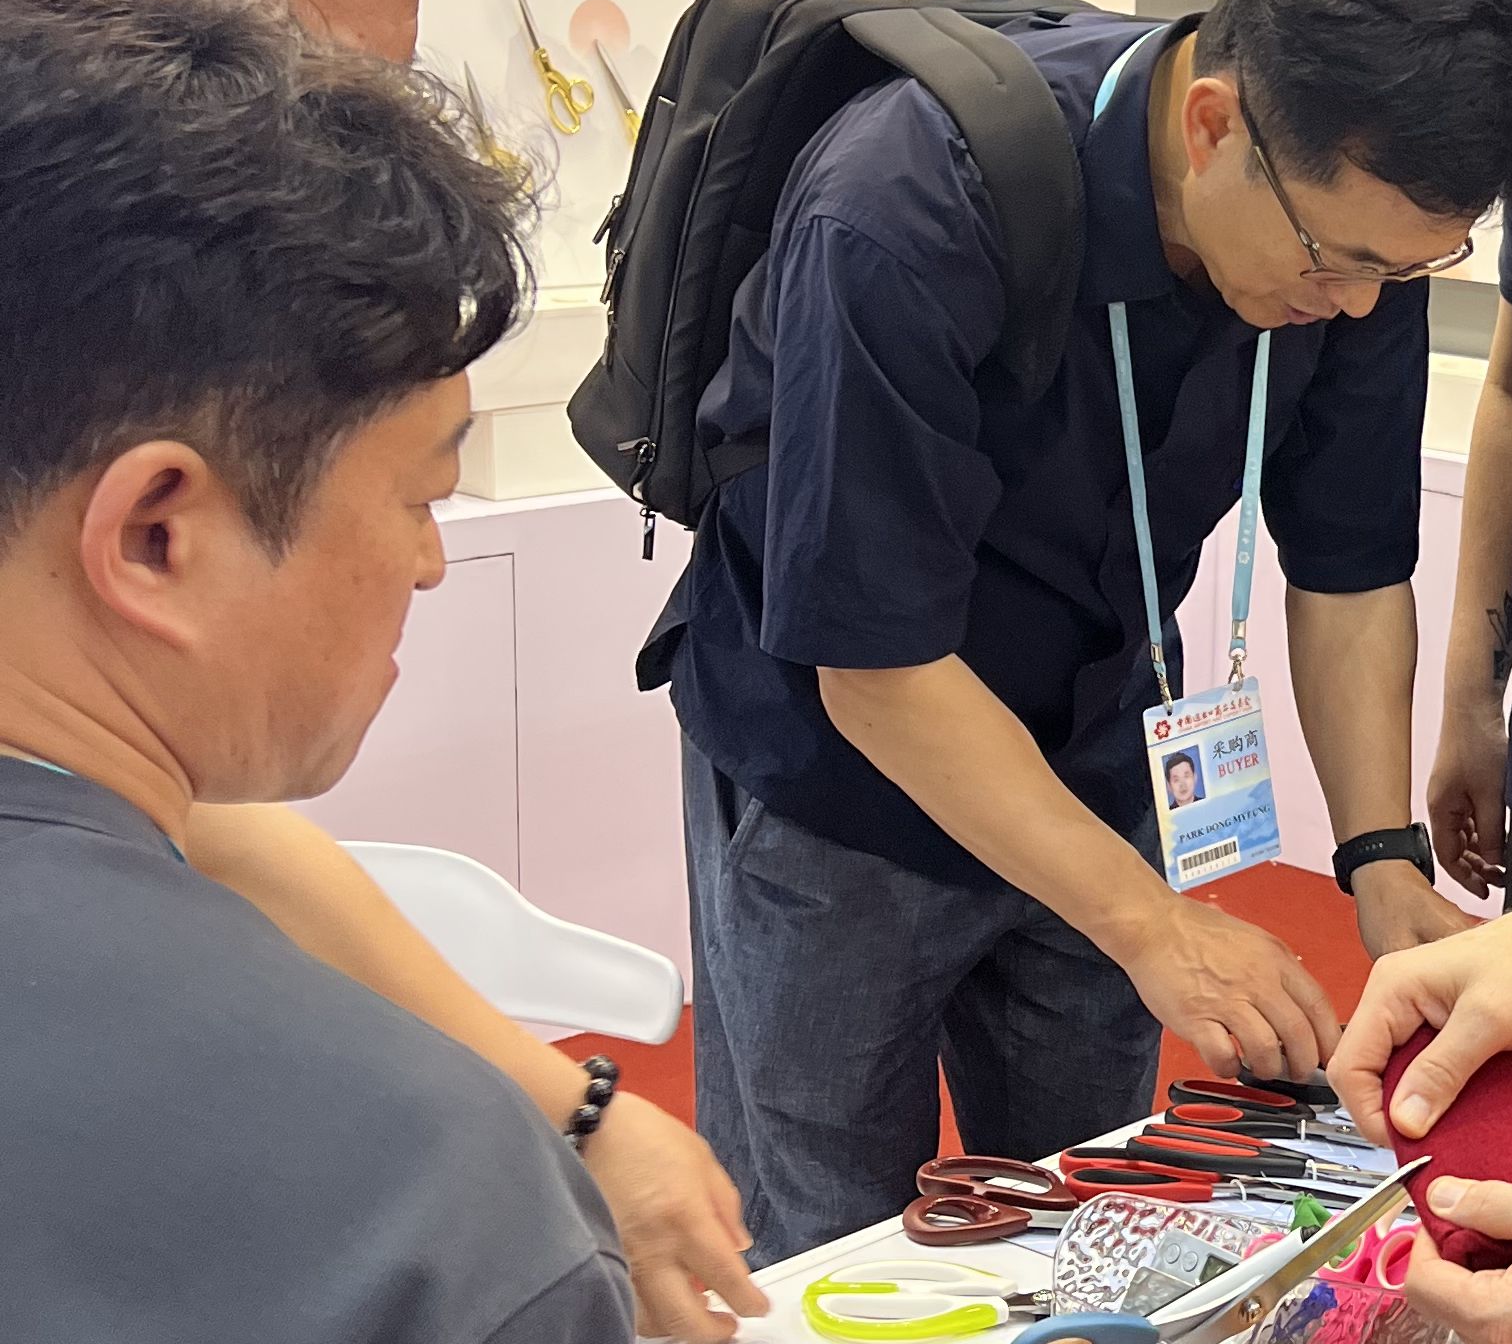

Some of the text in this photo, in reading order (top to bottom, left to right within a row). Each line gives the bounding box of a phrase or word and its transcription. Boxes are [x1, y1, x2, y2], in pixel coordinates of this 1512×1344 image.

[1212, 729, 1259, 760] 采购商
[1218, 752, 1260, 778] BUYER
[1179, 827, 1204, 843] PARK
[1206, 818, 1232, 834] DONG
